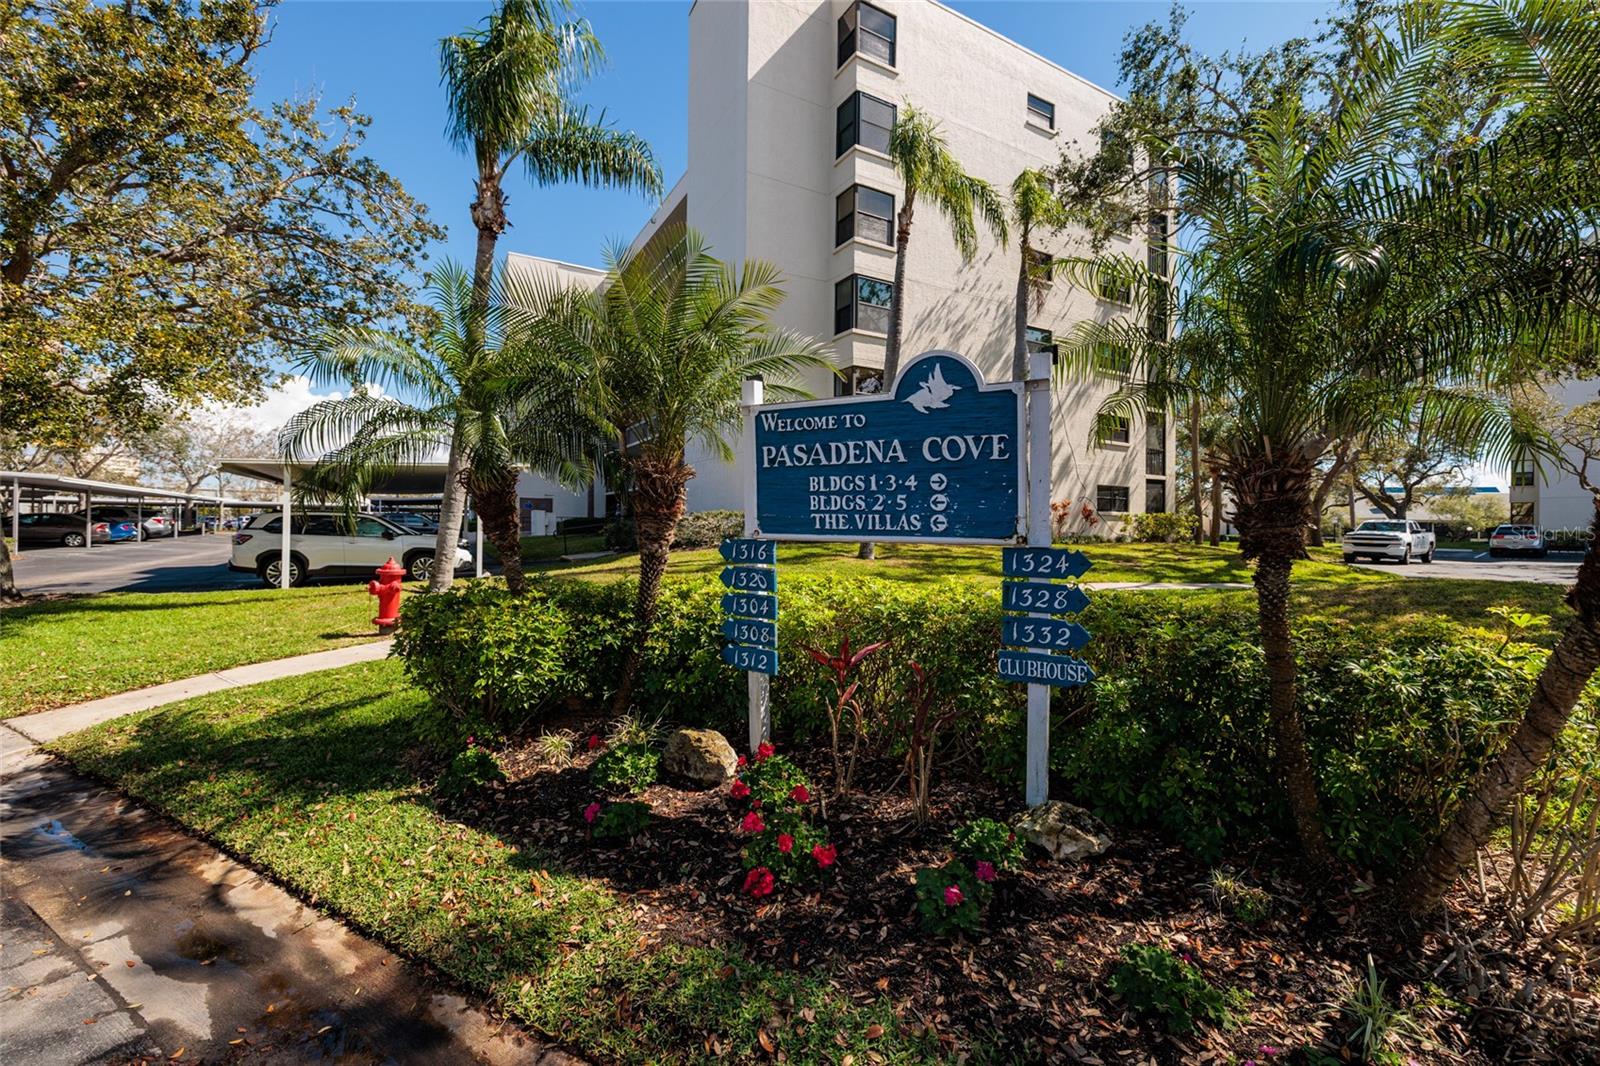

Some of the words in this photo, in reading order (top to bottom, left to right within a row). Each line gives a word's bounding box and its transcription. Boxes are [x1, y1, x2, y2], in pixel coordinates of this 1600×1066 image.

[841, 413, 867, 429] TO
[762, 438, 907, 468] PASADENA
[922, 433, 1010, 462] COVE
[809, 474, 866, 492] BLDGS
[809, 494, 866, 511] BLDGS
[810, 513, 849, 530] THE
[854, 513, 922, 531] VILLAS
[731, 543, 768, 560] 1316
[1012, 552, 1069, 574] 1324
[731, 571, 768, 589] 1320
[732, 597, 769, 615] 1304
[1011, 586, 1069, 610] 1328
[733, 624, 770, 643] 1308
[1012, 622, 1071, 646] 1332
[734, 651, 768, 671] 1312
[997, 657, 1088, 683] CLUBHOUSE
